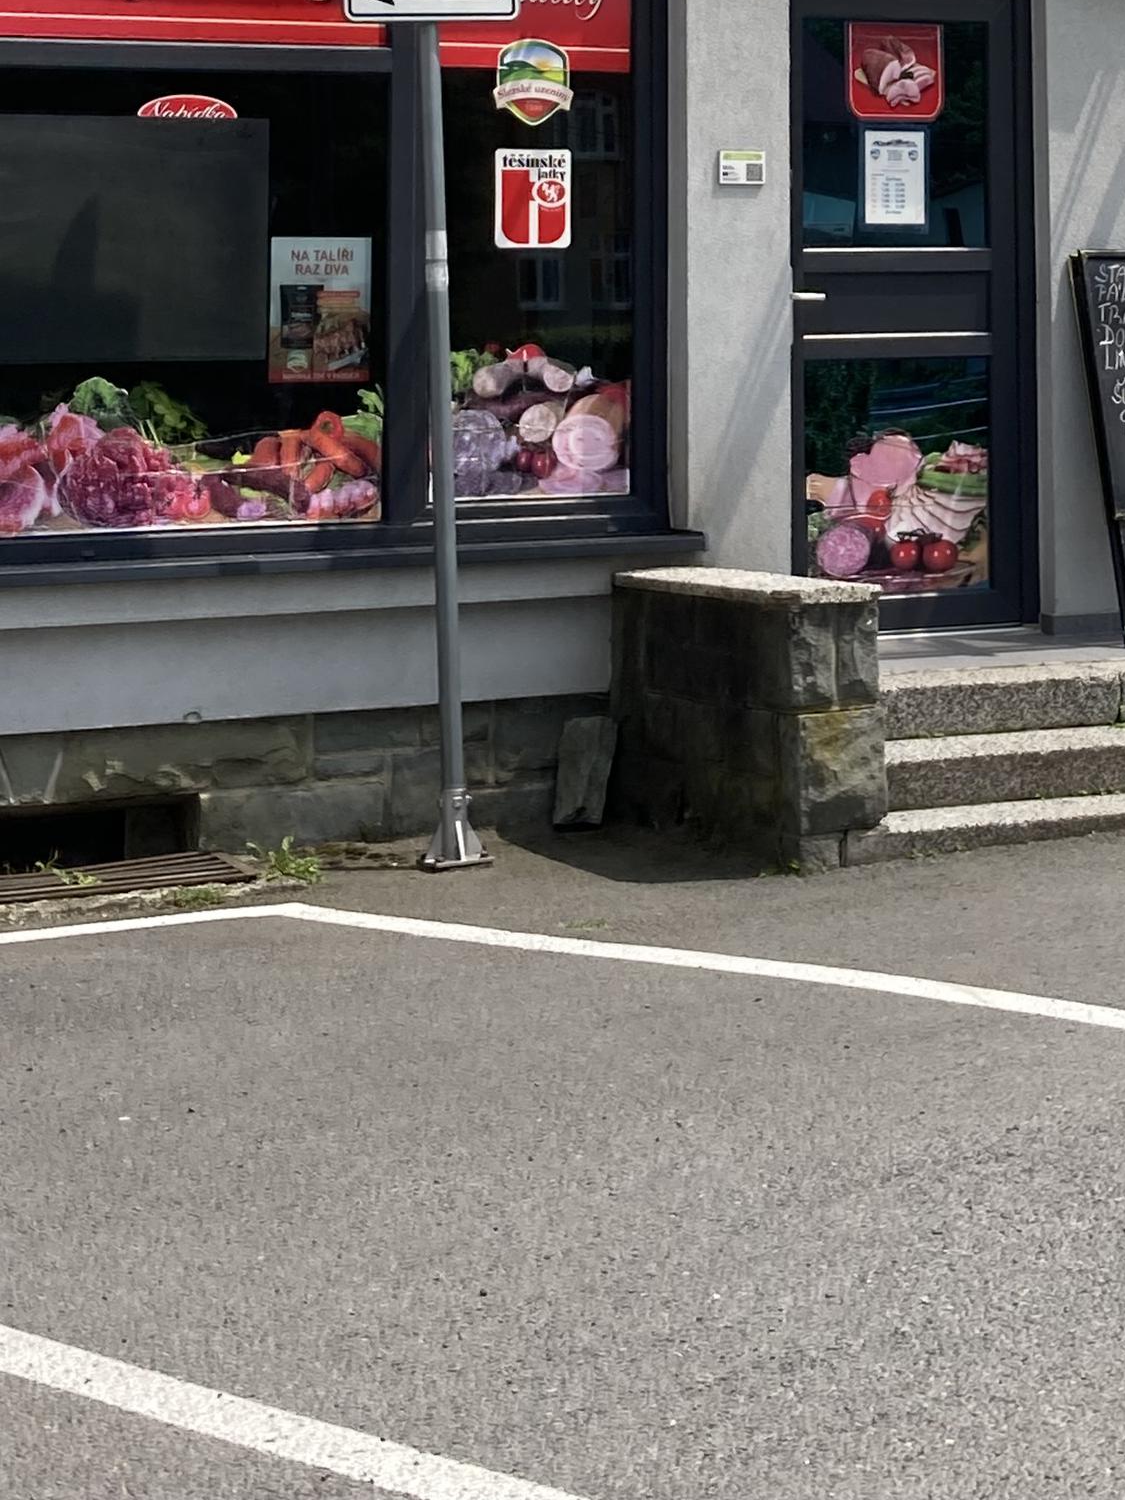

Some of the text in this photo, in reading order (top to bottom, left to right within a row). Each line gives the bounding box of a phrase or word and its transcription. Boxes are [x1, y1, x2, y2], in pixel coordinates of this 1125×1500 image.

[502, 153, 566, 168] těšínské
[290, 250, 309, 261] NA
[295, 264, 349, 276] RAZ DVA
